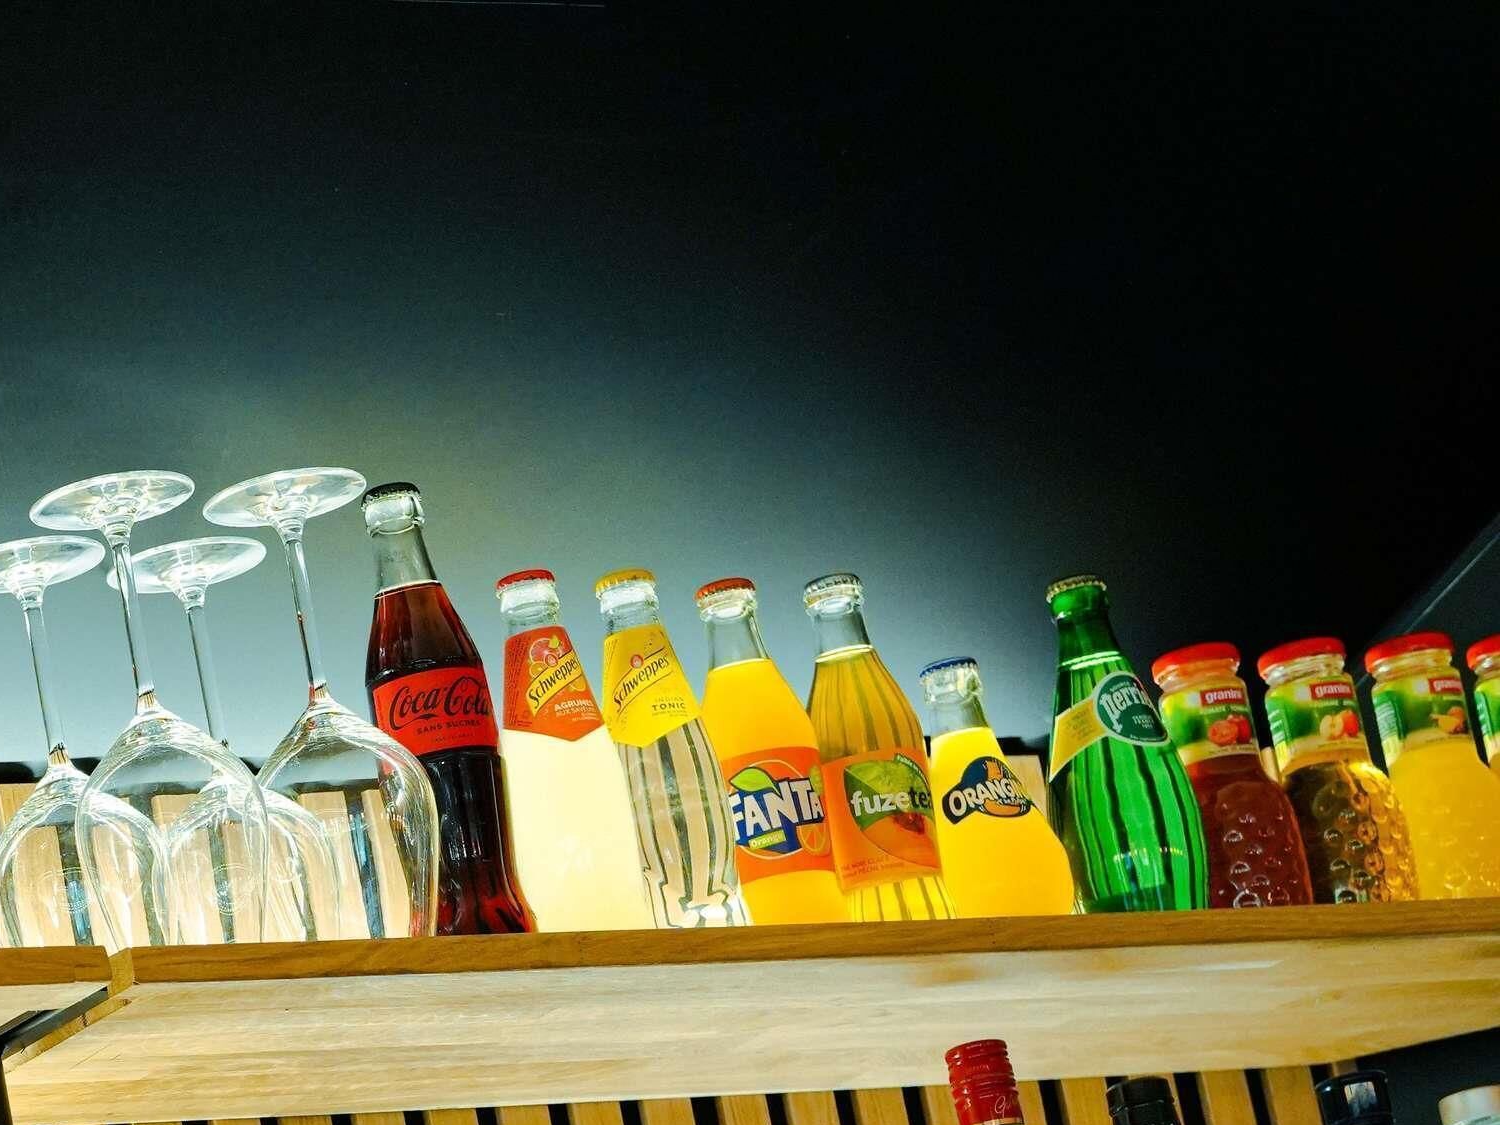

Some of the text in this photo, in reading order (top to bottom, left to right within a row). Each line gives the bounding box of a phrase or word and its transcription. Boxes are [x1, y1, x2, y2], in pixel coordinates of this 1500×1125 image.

[389, 675, 493, 731] Coca-Cola
[613, 655, 670, 713] Schweppes
[652, 702, 687, 712] TONIC
[728, 779, 826, 843] FANTA
[948, 777, 1024, 817] ORANG
